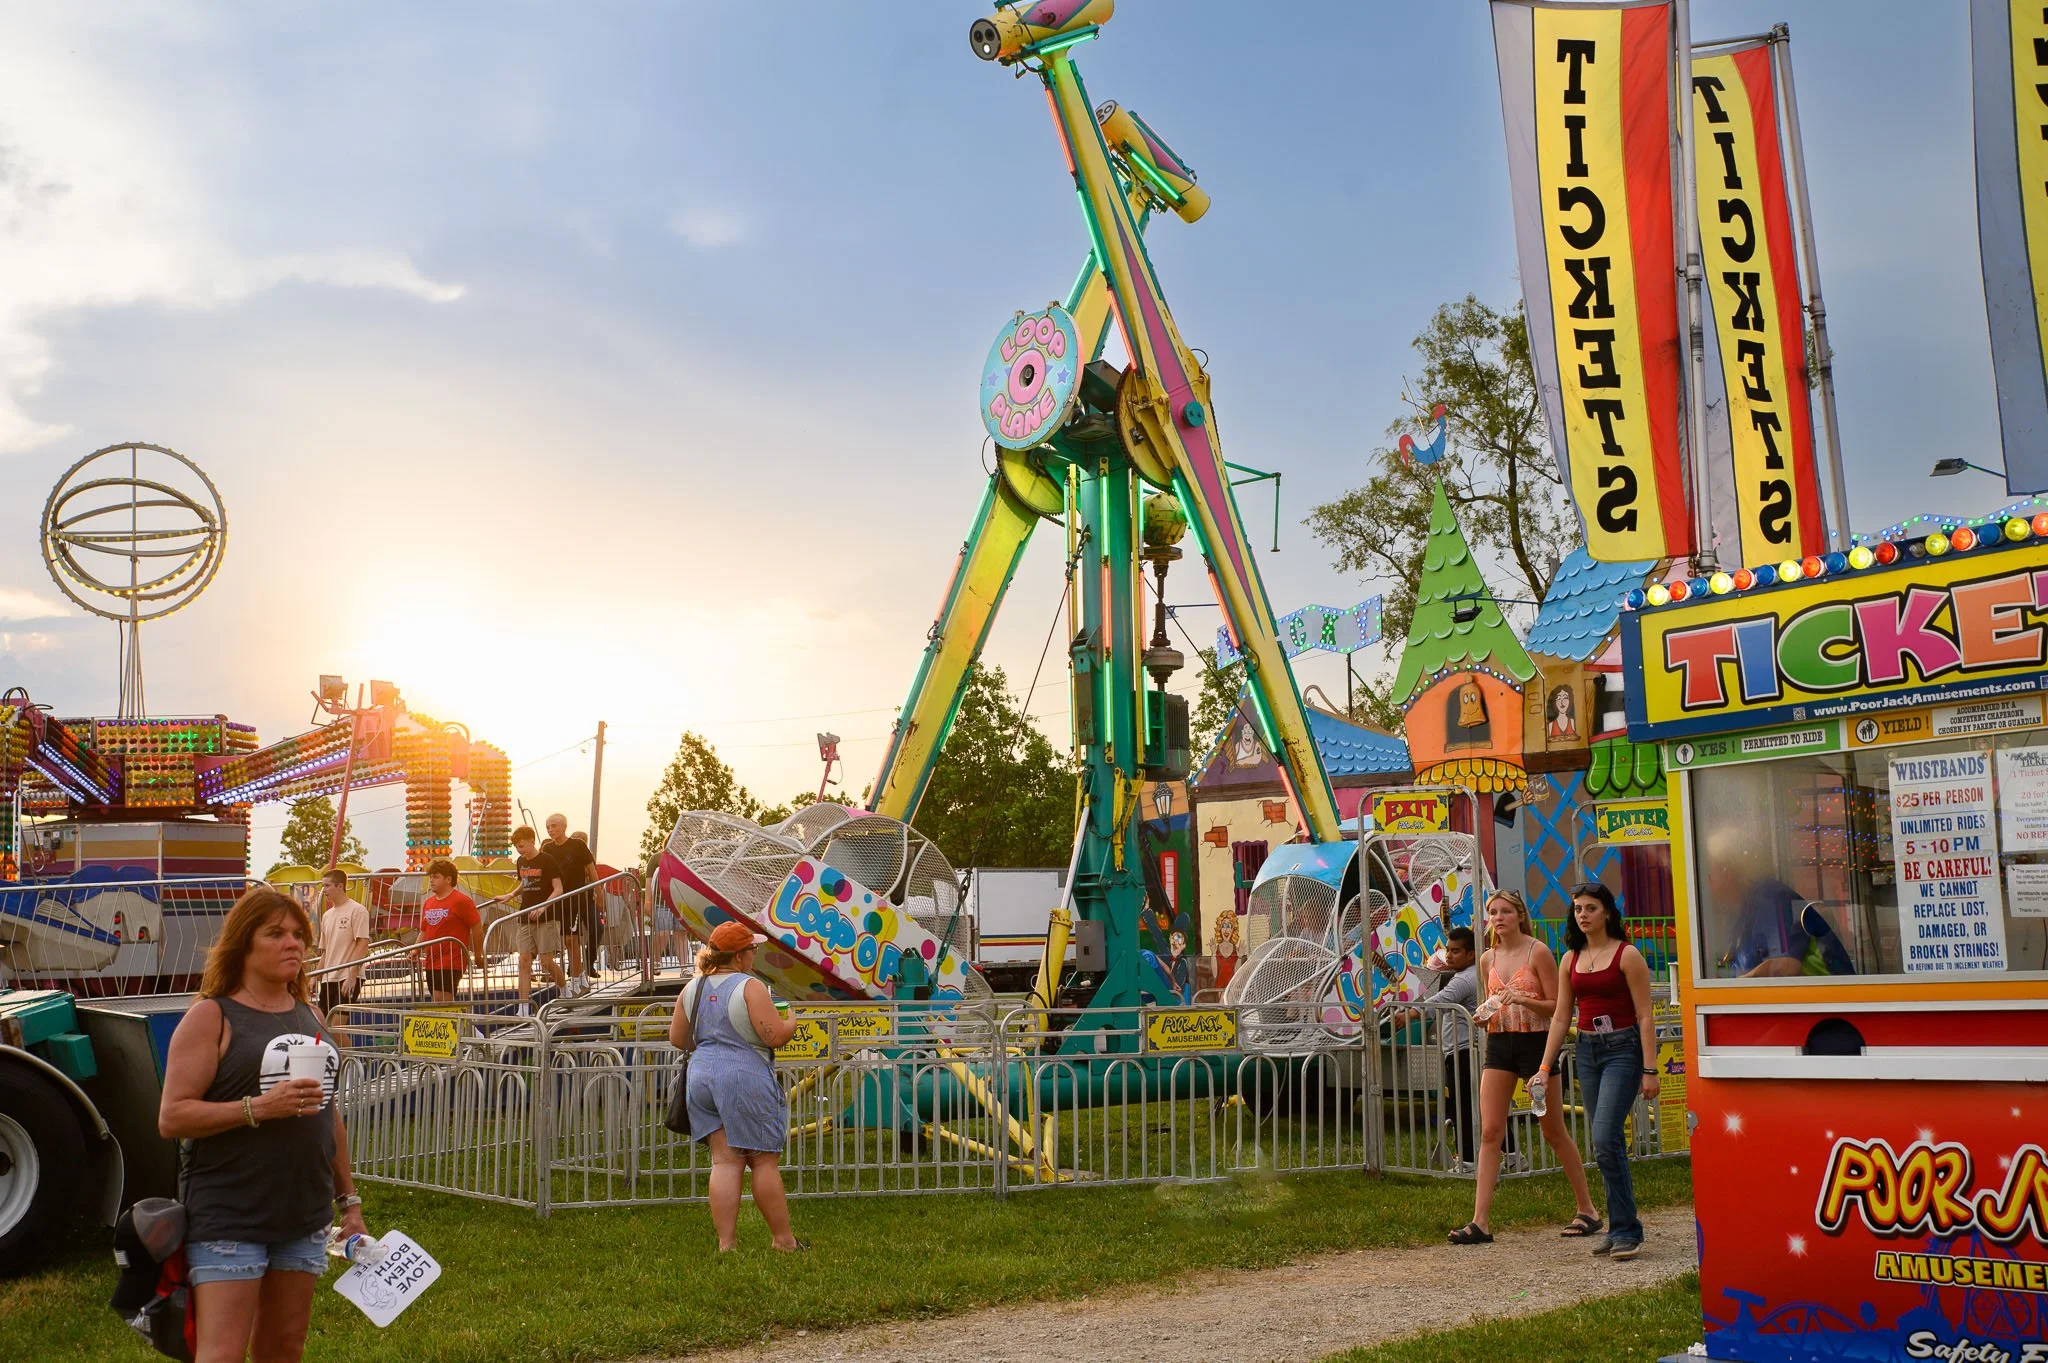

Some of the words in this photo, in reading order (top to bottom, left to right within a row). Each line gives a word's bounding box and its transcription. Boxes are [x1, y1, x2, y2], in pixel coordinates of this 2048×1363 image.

[1000, 316, 1066, 362] LOOP
[990, 388, 1056, 439] PLANE
[1664, 568, 2048, 711] TICKE
[1813, 679, 2036, 717] www.PoorJackAmusements.com
[1956, 703, 2000, 715] ACCOMPANIED
[2002, 702, 2011, 710] BY
[2011, 701, 2017, 709] A
[1881, 717, 1923, 735] YIELD
[1938, 725, 1960, 736] CHOSEN
[1961, 724, 1971, 733] BY
[1973, 721, 1998, 732] PARENT
[1999, 720, 2008, 729] OR
[2008, 716, 2041, 727] GUARDIAN
[1950, 713, 1986, 725] COMPETENT
[1987, 709, 2025, 722] CHAPERONE
[1698, 742, 1727, 757] YES
[1743, 736, 1790, 751] PERMITTED
[1791, 734, 1801, 745] TO
[1802, 731, 1823, 743] RIDE
[1895, 756, 1985, 781] WRISTBANDS
[1896, 793, 1920, 808] $25
[1923, 791, 1942, 806] PER
[1946, 787, 1984, 805] PERSON
[1383, 799, 1438, 827] EXIT
[1606, 808, 1670, 834] ENTER
[1900, 817, 1953, 835] UNLIMITED
[1957, 814, 1986, 830] RIDES
[2031, 830, 2048, 839] REF
[1953, 836, 1980, 851] PM
[1904, 861, 1921, 880] BE
[1927, 856, 1992, 879] CAREFUL!
[1920, 883, 1935, 898] WE
[1940, 880, 1979, 897] CANNOT
[1914, 902, 1957, 918] REPLACE
[1961, 901, 1989, 917] LOST,
[1918, 923, 1970, 939] DAMAGED,
[1974, 922, 1987, 937] OR
[1910, 944, 1949, 960] BROKEN
[1954, 942, 2000, 959] STRINGS!
[1907, 963, 1915, 972] NO
[1916, 963, 1934, 971] REFUND
[1954, 961, 1981, 970] INCLEMENT
[1982, 960, 2004, 969] WEATHER
[1167, 1034, 1218, 1043] AMUSEMENTS
[1815, 1136, 1976, 1236] POOR
[374, 1243, 411, 1277] BOTH
[384, 1252, 422, 1286] THEM
[396, 1260, 432, 1294] LOVE
[1875, 1250, 2048, 1294] AMUSEME
[1906, 1330, 2011, 1363] Safety
